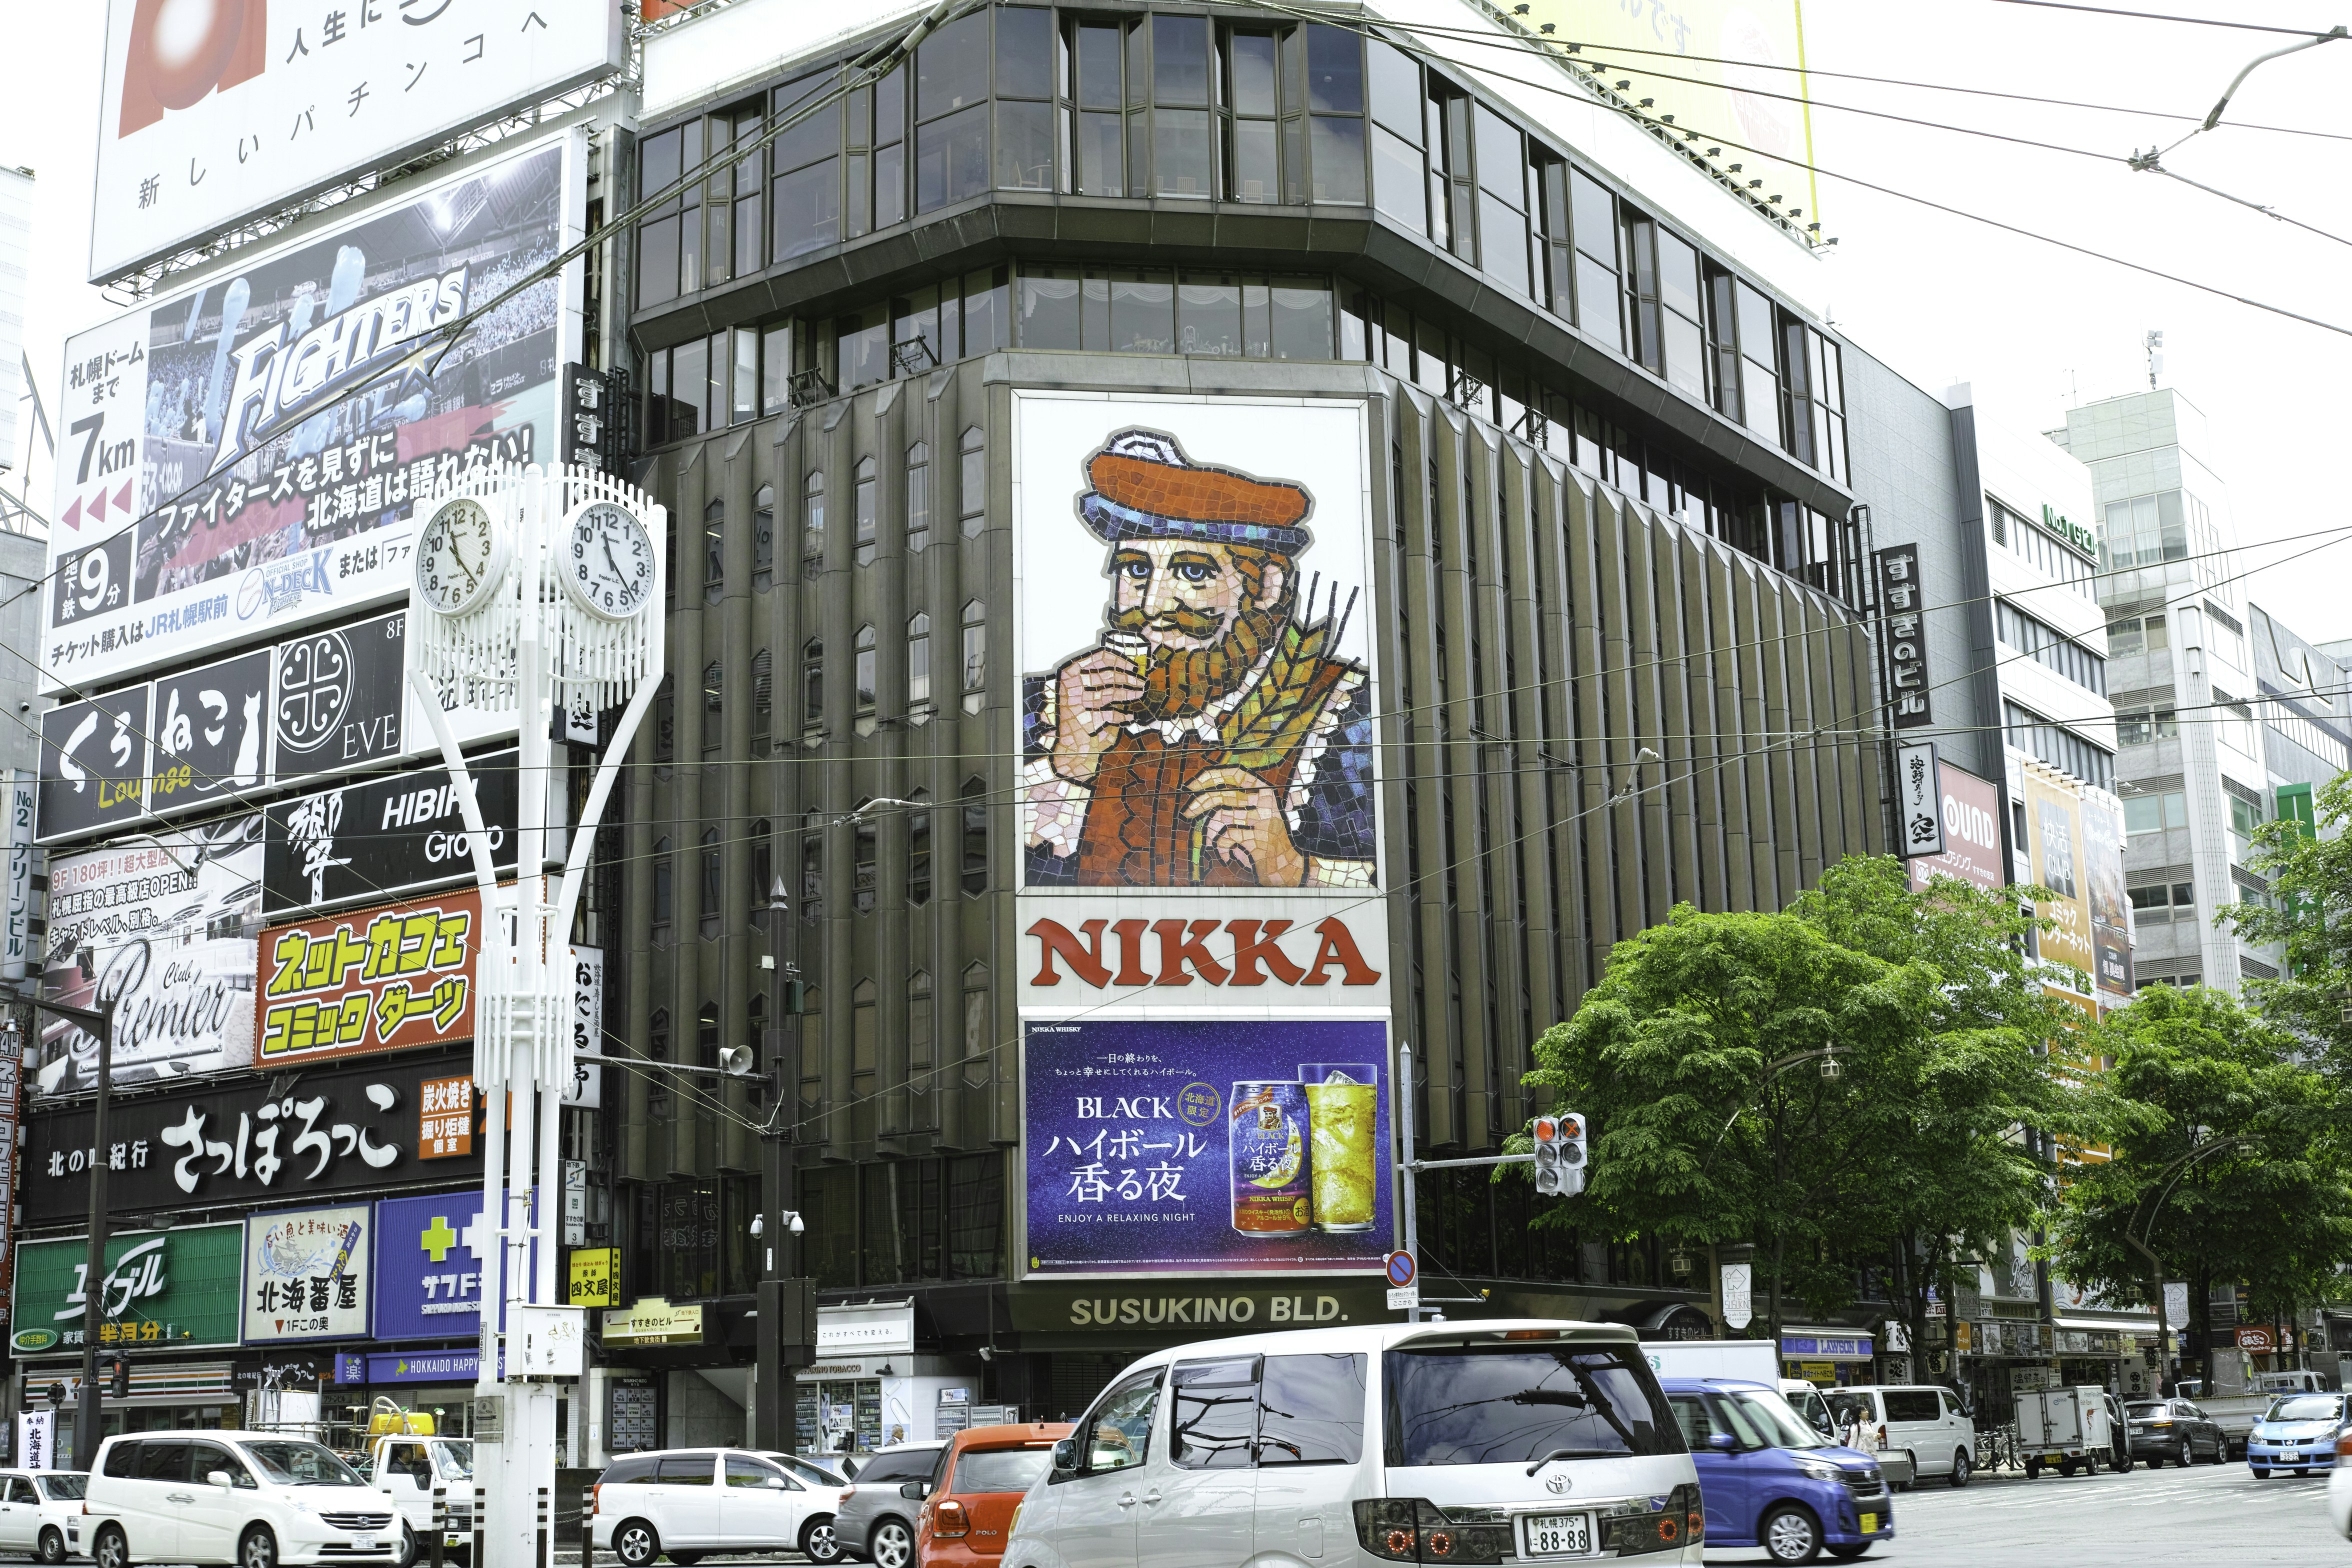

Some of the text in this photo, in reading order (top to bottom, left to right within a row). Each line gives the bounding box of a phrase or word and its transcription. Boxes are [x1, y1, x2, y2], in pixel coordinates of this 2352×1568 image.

[138, 11, 548, 210] 新しいパチンコへ
[70, 341, 144, 390] 札幌ドーム
[206, 265, 472, 478] FIGHTERS
[92, 376, 120, 404] まで
[158, 431, 394, 540] ファイターズを見ずに
[452, 508, 466, 525] 12
[470, 511, 476, 526] 1
[589, 514, 601, 530] 11
[604, 512, 618, 530] 12
[440, 518, 450, 534] 11
[478, 522, 487, 538] 2
[624, 525, 630, 540] 1
[578, 526, 592, 543] 10
[430, 536, 443, 553] 10
[482, 540, 490, 556] 3
[574, 543, 584, 558] 9
[632, 540, 642, 556] 2
[266, 558, 308, 578] OFFICIAL SHOP
[426, 557, 434, 572] 9
[476, 562, 484, 576] 4
[579, 564, 588, 580] 8
[636, 562, 646, 577] 3
[430, 576, 438, 590] 8
[599, 574, 611, 582] Poplar
[440, 586, 448, 602] 7
[466, 579, 475, 594] 5
[590, 582, 600, 597] 7
[630, 580, 639, 594] 4
[452, 588, 460, 603] 6
[604, 592, 614, 606] 6
[620, 590, 628, 605] 5
[386, 618, 404, 640] 8F
[1886, 554, 1925, 716] すすきのビル
[342, 714, 400, 760] EVE
[99, 764, 192, 809] Lounge
[16, 790, 34, 809] No.
[17, 808, 28, 828] 2
[2044, 816, 2068, 854] 快活
[424, 825, 504, 862] Grop
[1972, 865, 1995, 882] すすきの支店
[2046, 853, 2071, 881] CLUB
[52, 868, 68, 892] 9F
[6, 842, 31, 956] グリーンビル
[2049, 902, 2077, 928] コミック
[266, 910, 470, 996] ネットカフェ
[1025, 916, 1382, 990] NIKKA
[163, 959, 191, 990] Club
[262, 978, 467, 1056] コミック ダーツ
[1096, 1052, 1162, 1064] 一日の終わりを、
[1055, 1066, 1197, 1078] ちょっと幸せにしてくれるハイボール。
[422, 1082, 472, 1112] 炭火焼き
[1185, 1092, 1215, 1106] 北海道
[1076, 1096, 1174, 1119] BLACK
[1186, 1105, 1210, 1118] 限定
[161, 1083, 402, 1194] さっぽろっこ
[433, 1138, 458, 1154] 個室
[1042, 1128, 1207, 1160] ハイボール
[1242, 1142, 1300, 1155] ハイボール
[48, 1139, 149, 1177] 北の紀行
[1249, 1155, 1296, 1172] 香る夜
[1066, 1162, 1187, 1203] 香る夜
[1058, 1212, 1196, 1223] ENJOY A RELAXING NIGHT
[266, 1219, 349, 1248] 旨い魚と美味い酒
[572, 1233, 577, 1242] 3
[256, 1274, 358, 1313] 北海番屋
[571, 1278, 609, 1298] 四文屋
[1070, 1296, 1348, 1326] SUSUKINO BLD.
[286, 1316, 328, 1332] 1Fこの奥
[630, 1318, 672, 1328] すすきのビル
[18, 1334, 48, 1346] 仲介手数料
[634, 1336, 660, 1344] 地下飲食街
[822, 1329, 892, 1338] これがすべてを変える。
[2242, 1334, 2264, 1346] 銀だこ
[1820, 1339, 1856, 1354] LAWSON
[410, 1358, 478, 1374] HOKKAIDO HAPPY
[828, 1364, 861, 1374] TOBACCO
[26, 1416, 44, 1426] 奉納
[1540, 1517, 1574, 1529] 札幌 375
[1530, 1530, 1586, 1551] に 88-88
